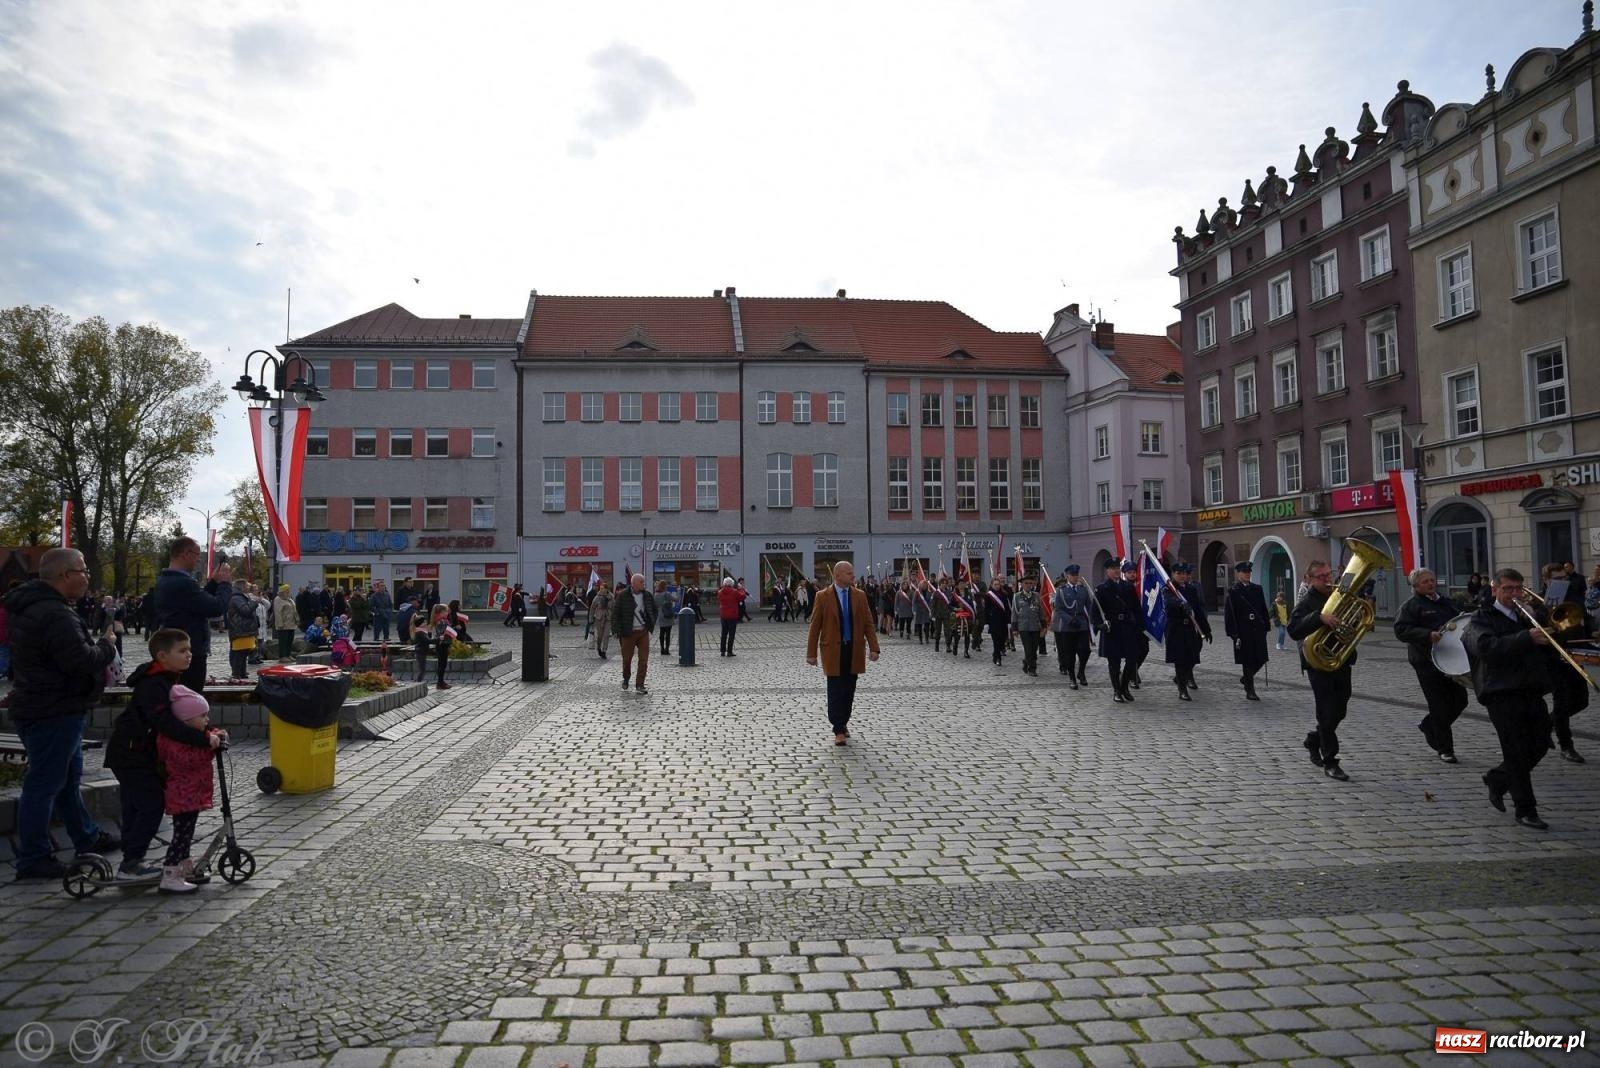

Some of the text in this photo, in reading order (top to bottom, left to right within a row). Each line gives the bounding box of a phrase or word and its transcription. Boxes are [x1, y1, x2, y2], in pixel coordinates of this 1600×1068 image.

[1242, 501, 1295, 521] KANTOR
[301, 531, 409, 551] BOLKO
[646, 541, 705, 551] JUBILER
[765, 542, 796, 550] BOLKO
